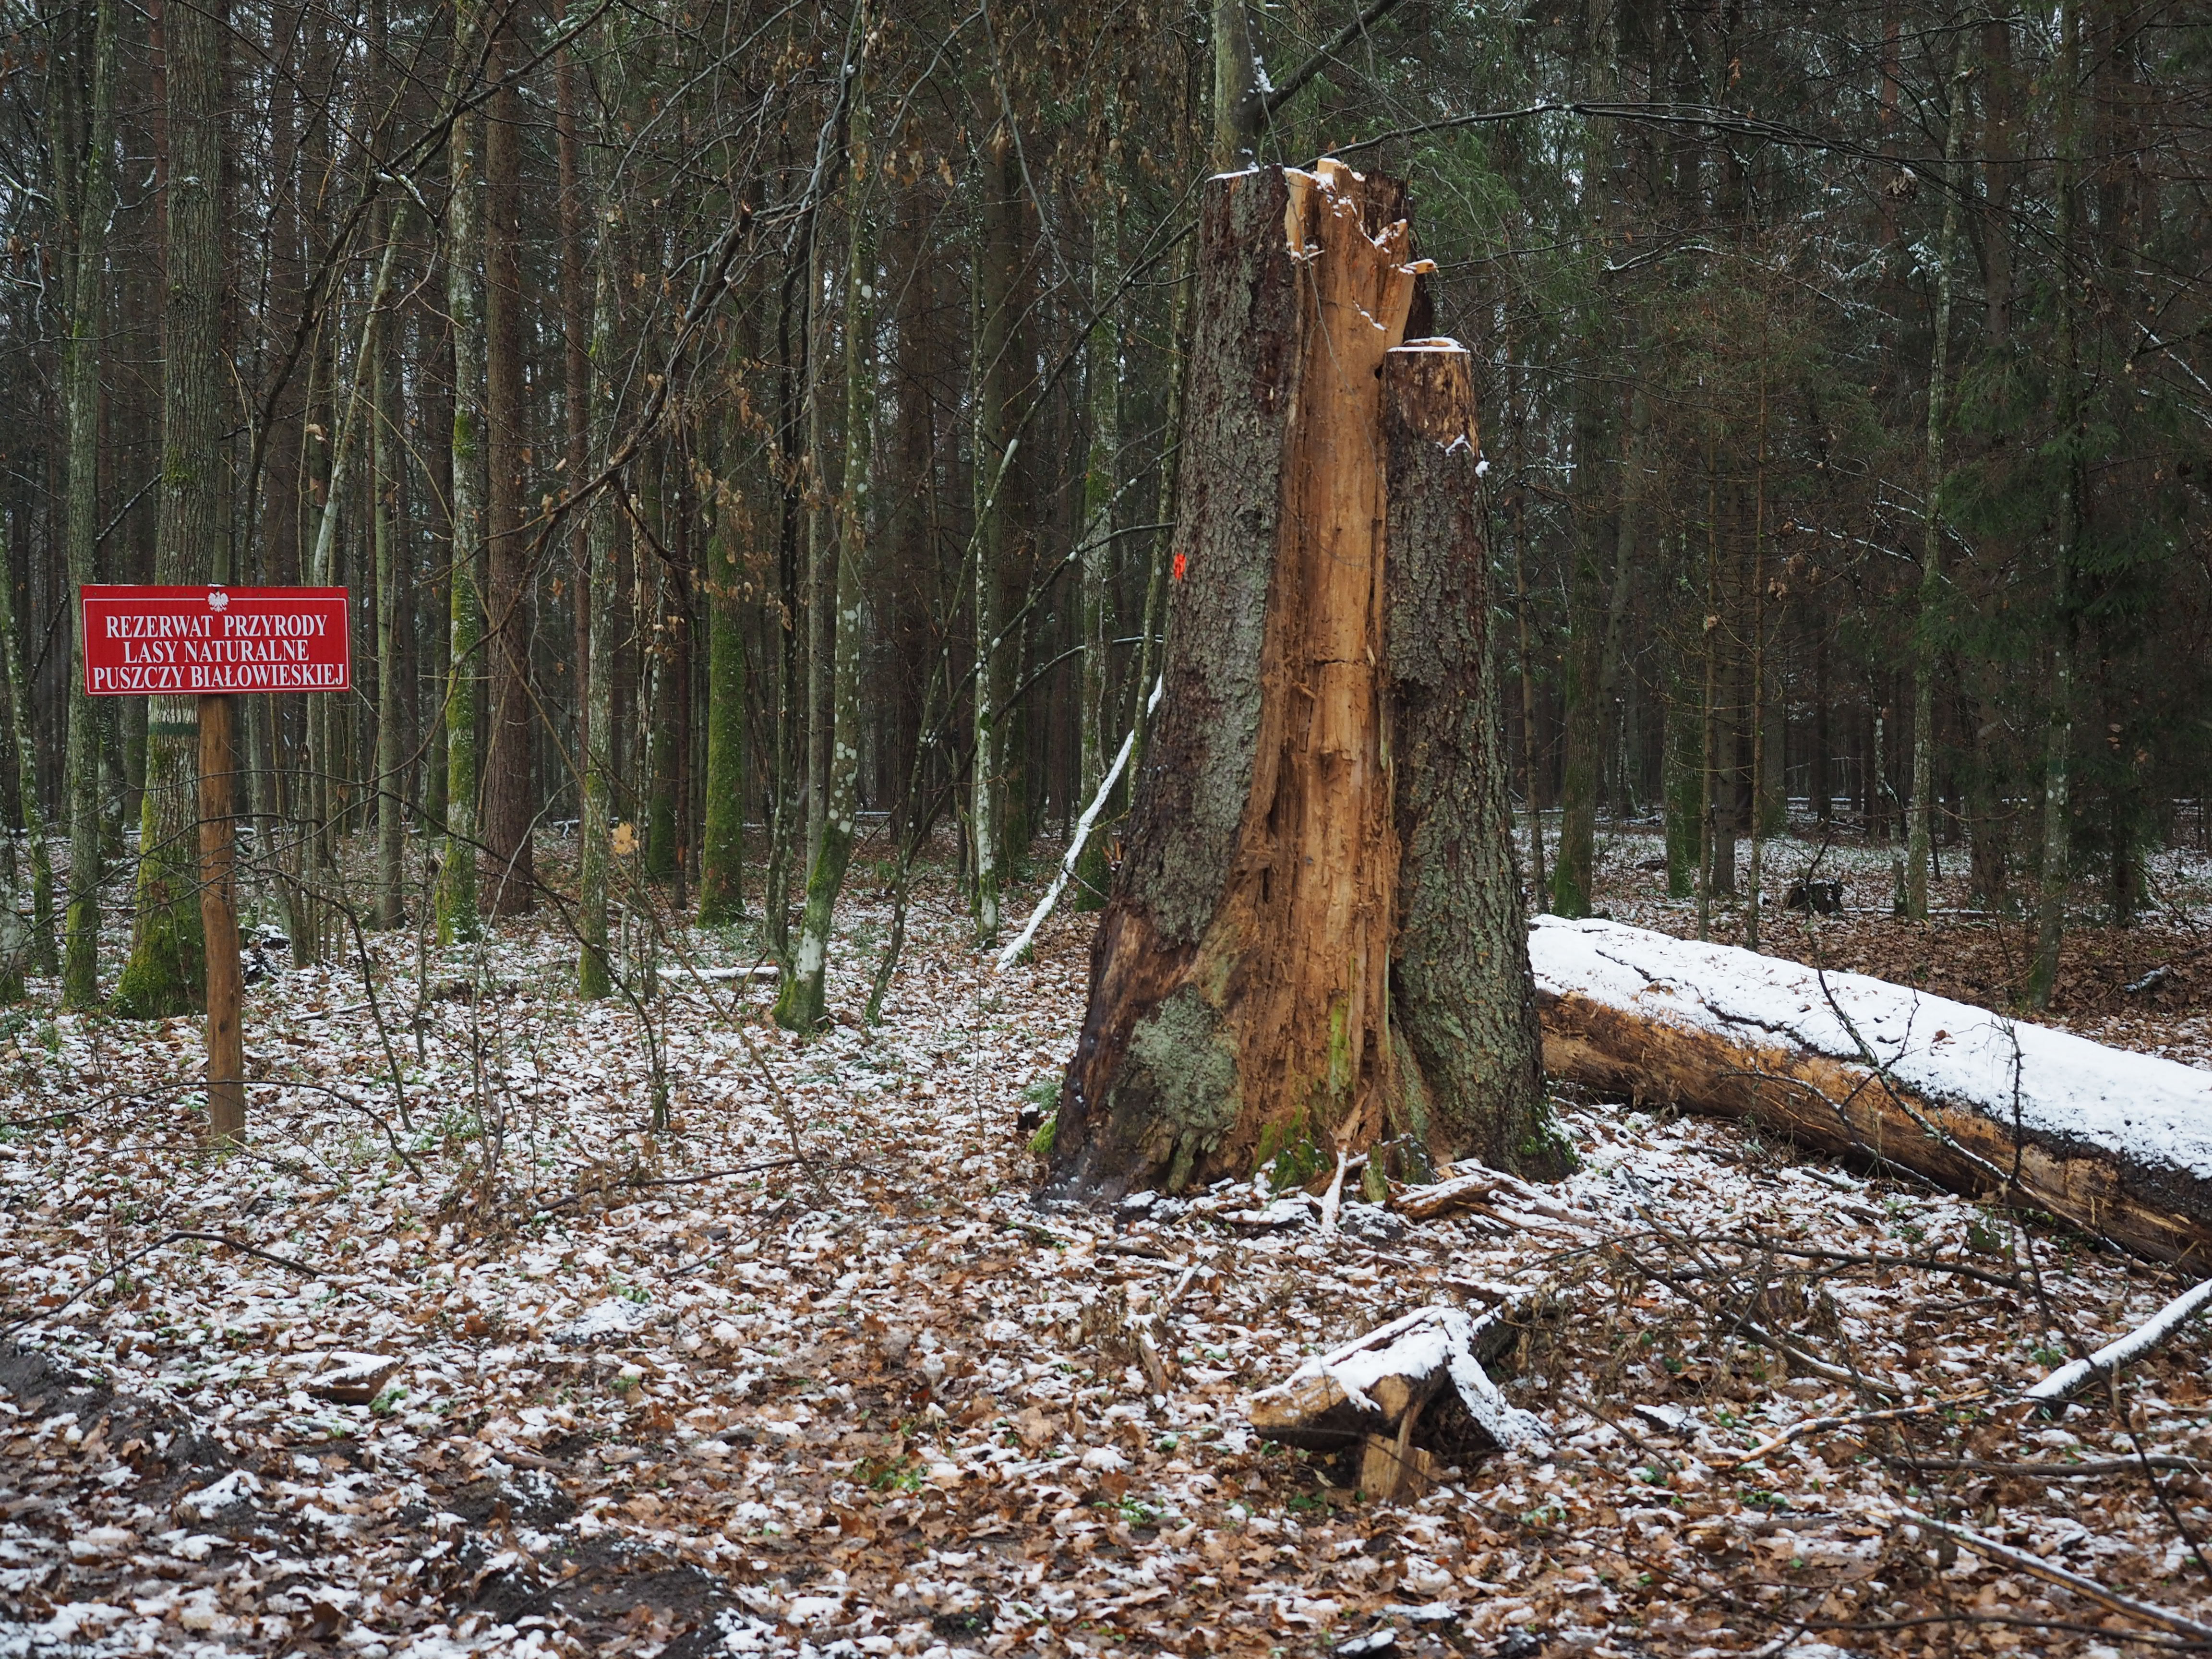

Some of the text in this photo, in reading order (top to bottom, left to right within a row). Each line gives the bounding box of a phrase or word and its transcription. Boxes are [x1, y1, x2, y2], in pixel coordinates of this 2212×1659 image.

[106, 614, 327, 638] REZERWAT PRZYRODY
[124, 639, 310, 663] LASY NATURALNE
[93, 663, 345, 690] PUSZCZY BIAŁOWIESKIEJ
